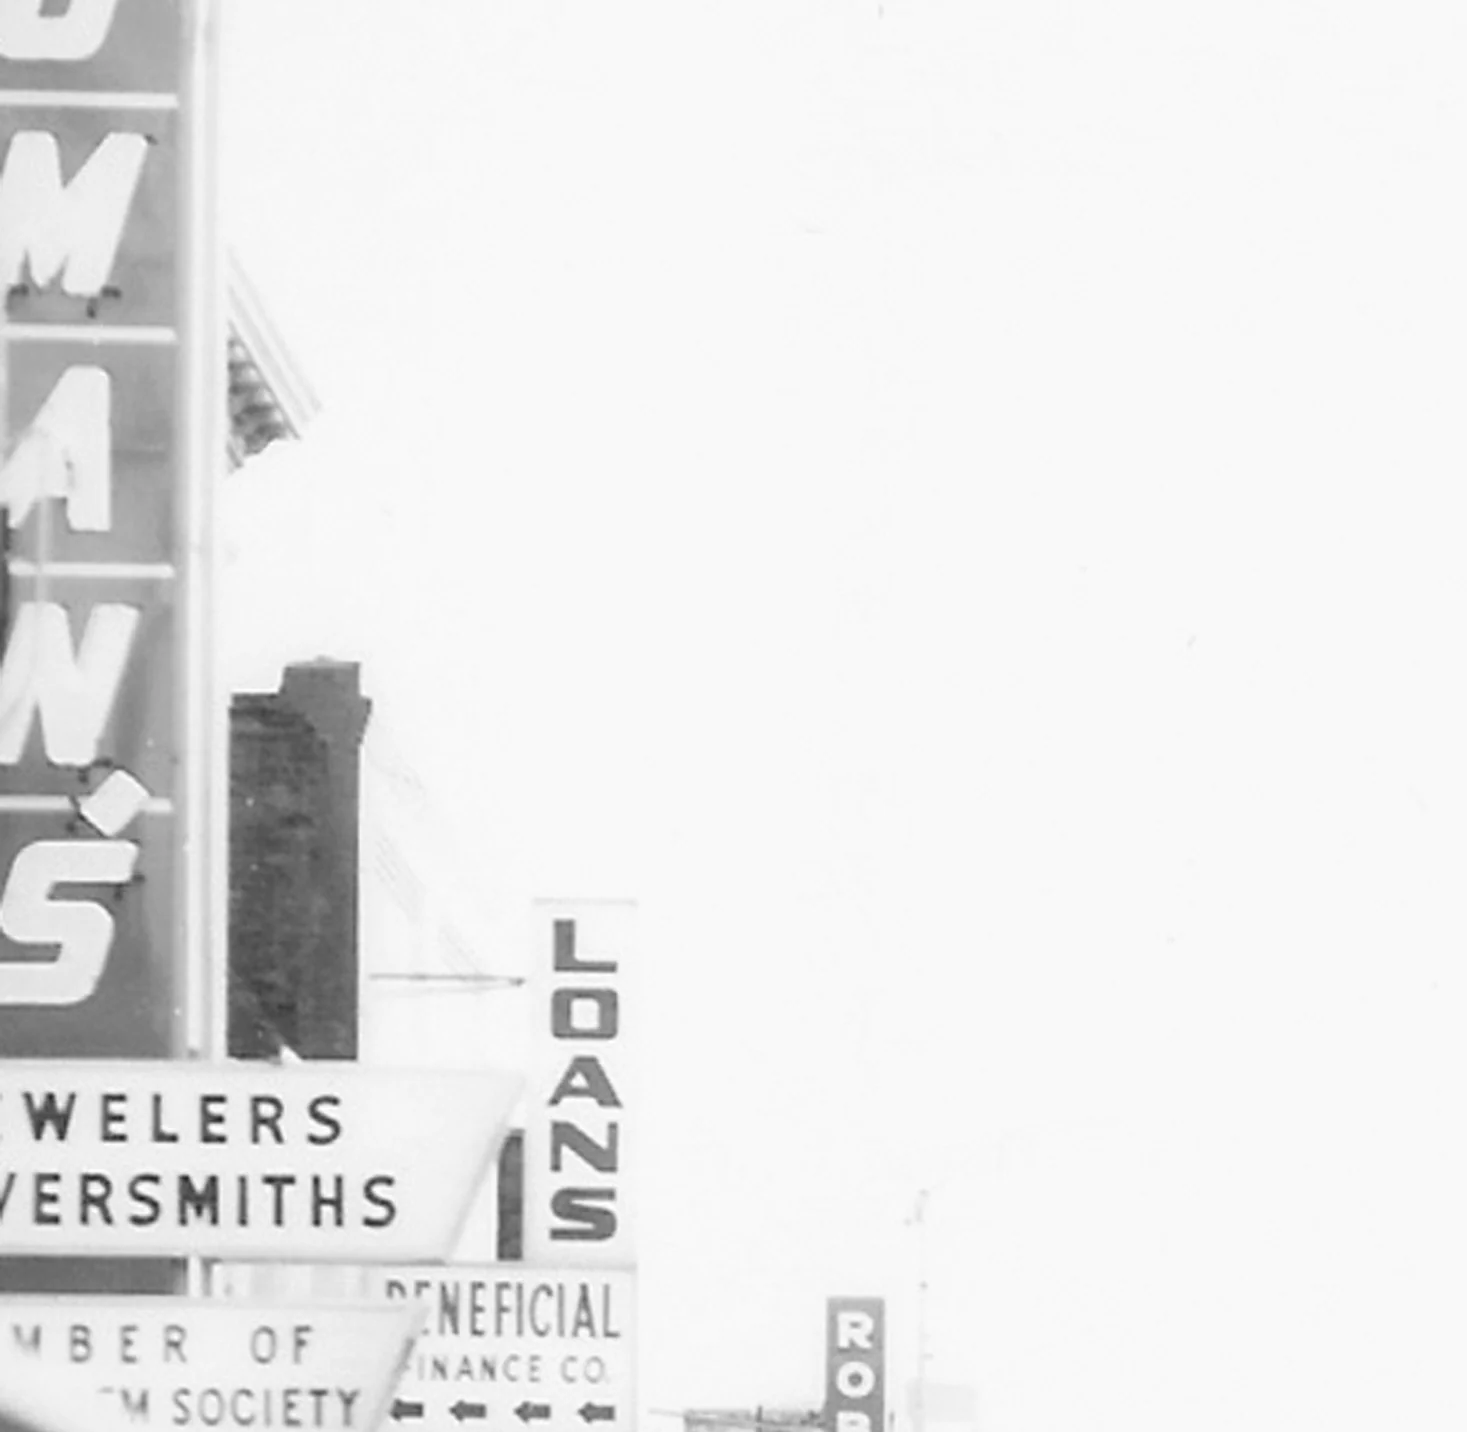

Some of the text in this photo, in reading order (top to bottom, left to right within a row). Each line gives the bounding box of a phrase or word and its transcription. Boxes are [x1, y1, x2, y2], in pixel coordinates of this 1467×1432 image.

[548, 917, 623, 1241] LOANS
[0, 1092, 343, 1145] WELERS
[249, 1325, 314, 1364] OF
[405, 1354, 543, 1383] INANCE
[172, 1387, 361, 1427] SOCIETY
